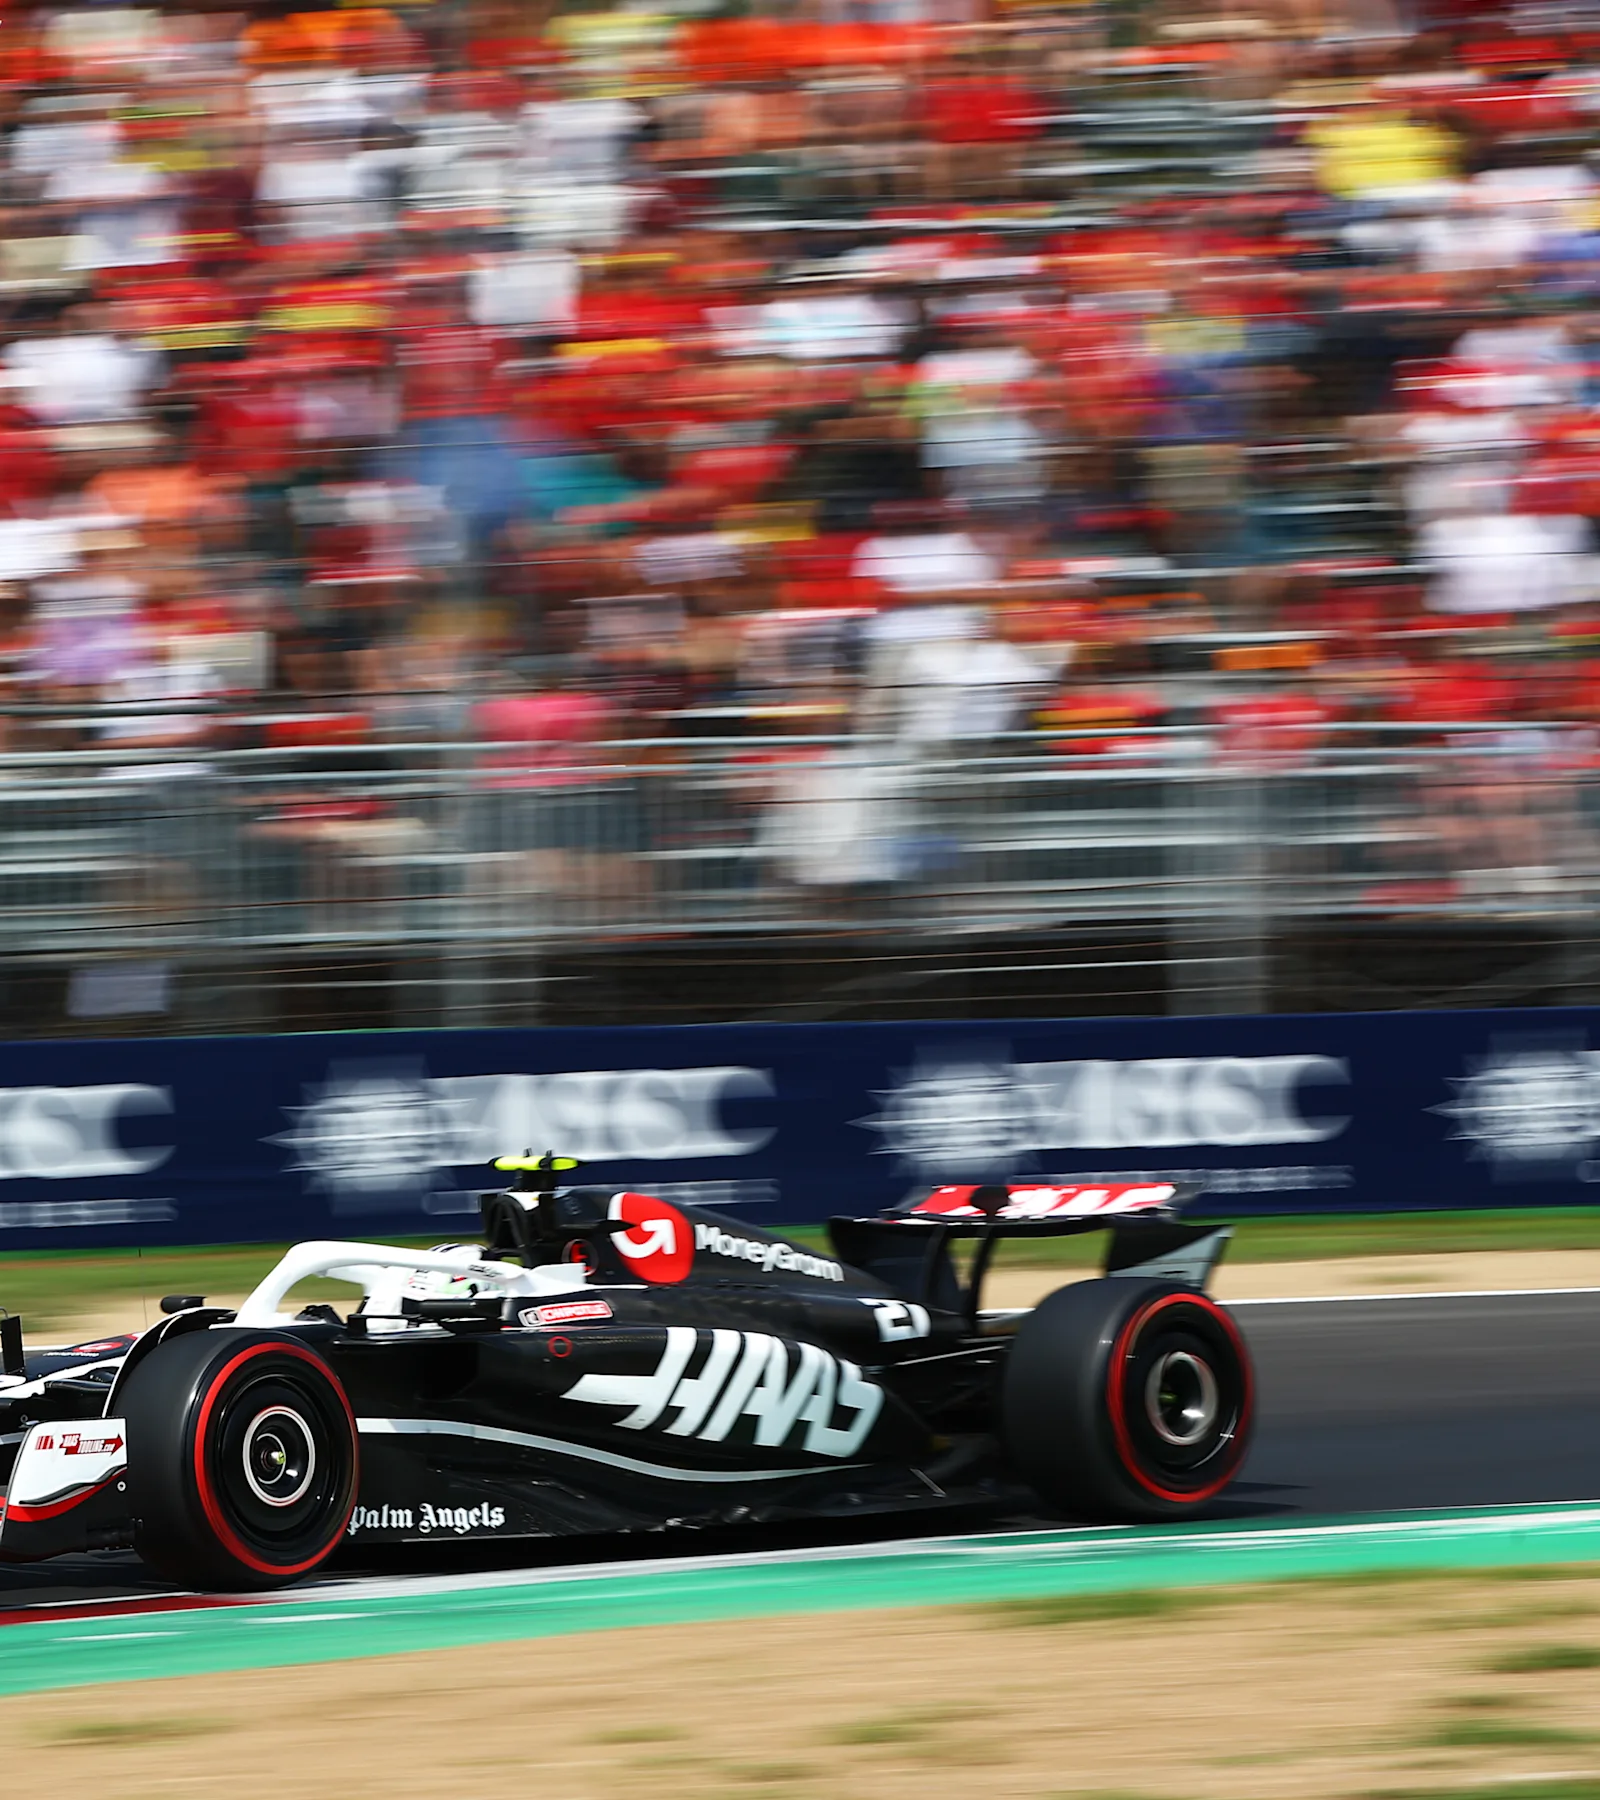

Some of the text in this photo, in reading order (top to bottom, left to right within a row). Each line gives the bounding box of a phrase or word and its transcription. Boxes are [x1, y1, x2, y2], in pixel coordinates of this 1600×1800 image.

[694, 1223, 844, 1282] MoneyGram
[559, 1326, 884, 1458] HAAS
[347, 1502, 506, 1536] Palm Angels
